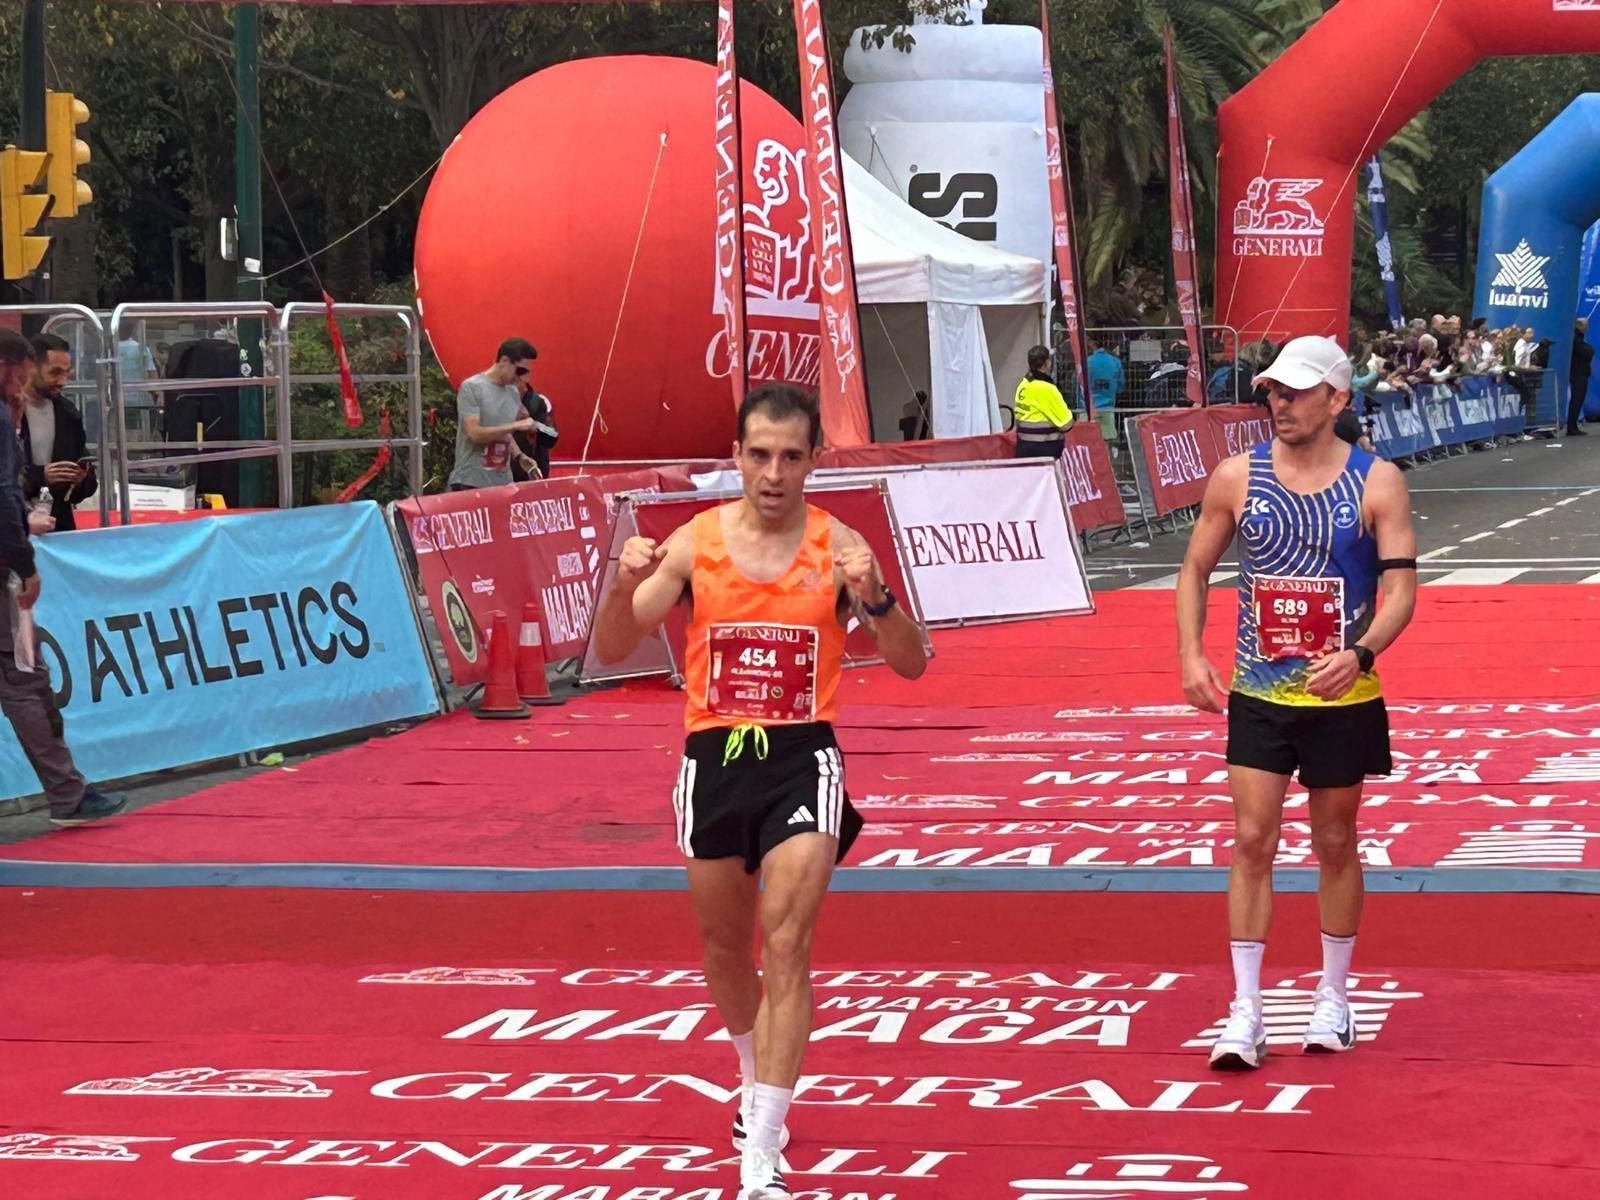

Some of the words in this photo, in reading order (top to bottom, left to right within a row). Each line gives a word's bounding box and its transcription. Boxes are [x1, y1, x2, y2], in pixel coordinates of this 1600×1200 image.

[1233, 238, 1323, 256] GENERALI
[1489, 289, 1549, 309] luanvi
[904, 520, 1045, 567] ENERALI
[1273, 598, 1308, 616] 589
[85, 581, 370, 703] ATHLETICS
[738, 647, 777, 668] 454
[560, 968, 1196, 992] GEERALI
[817, 996, 1149, 1015] MARATÓN
